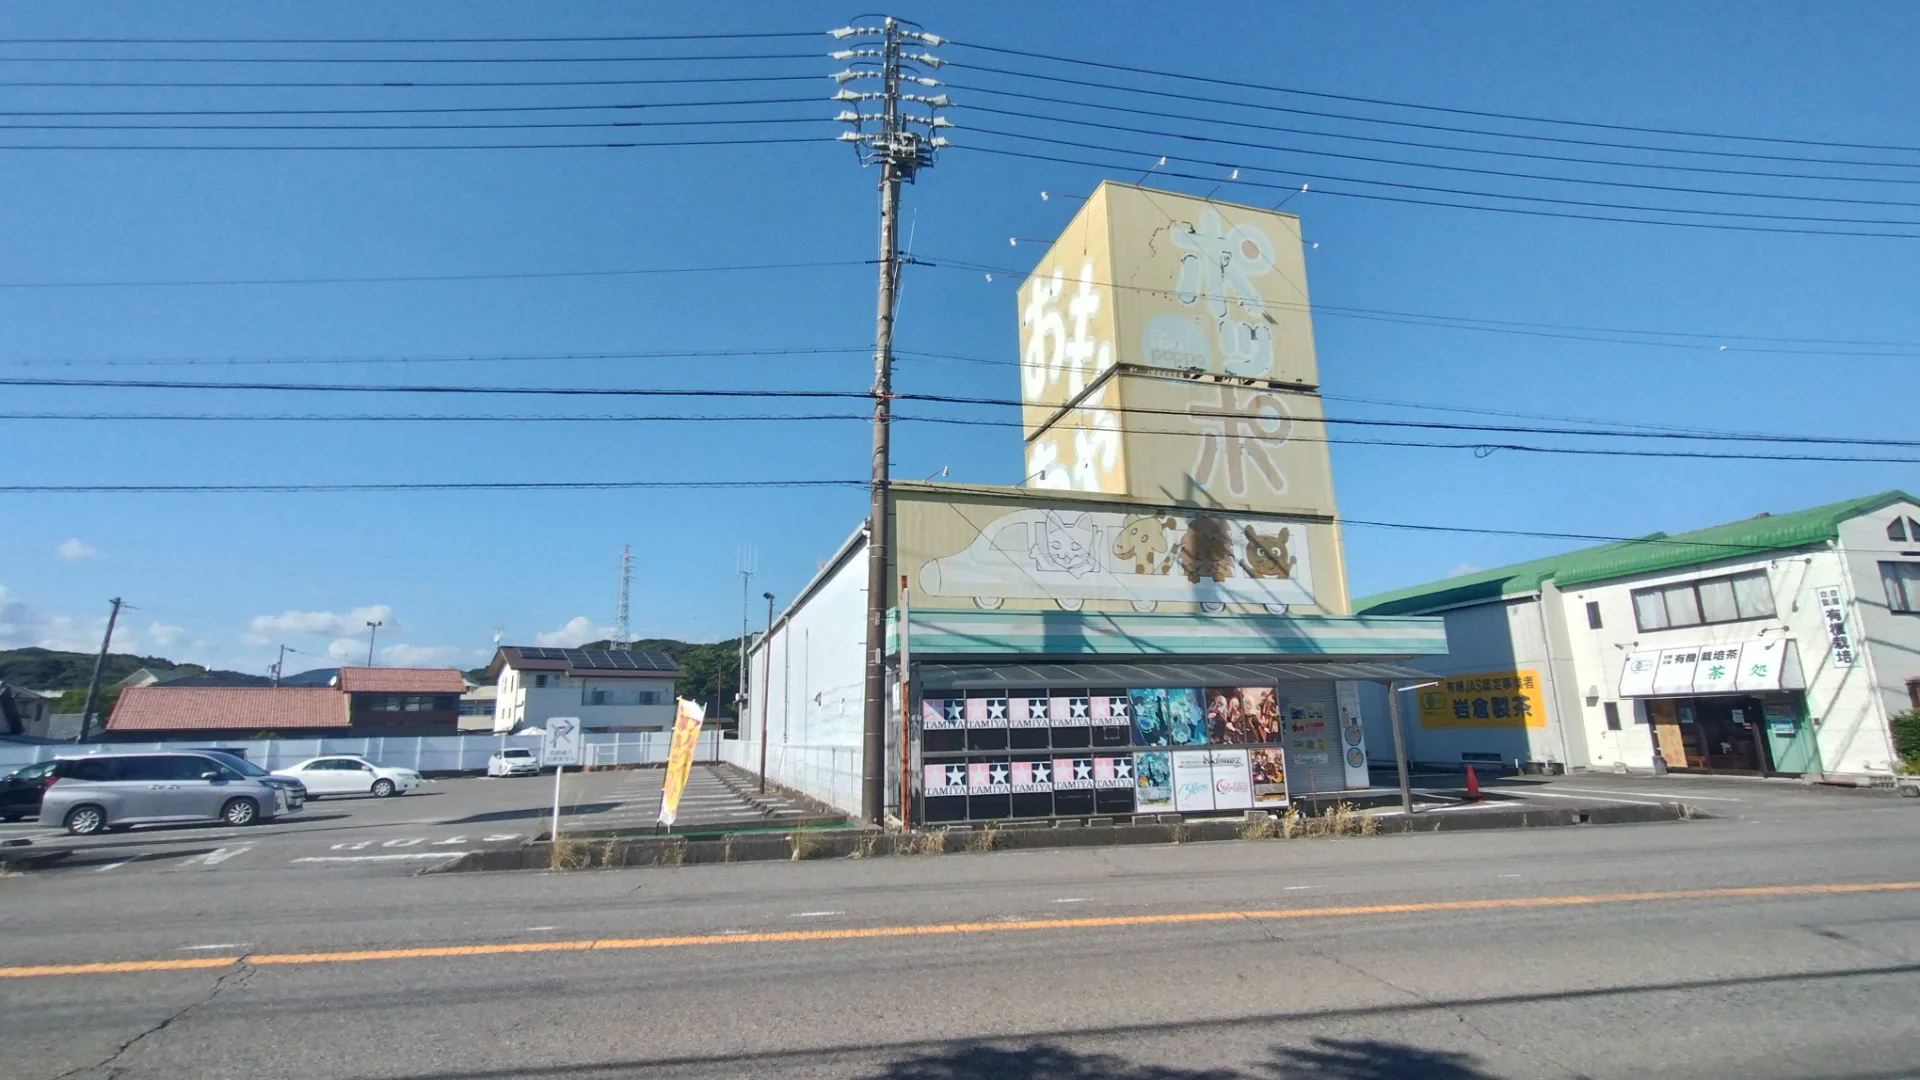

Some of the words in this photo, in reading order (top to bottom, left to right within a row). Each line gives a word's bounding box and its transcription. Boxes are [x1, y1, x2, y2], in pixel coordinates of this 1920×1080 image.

[1452, 695, 1533, 719] 岩倉製茶
[925, 720, 965, 729] TAMIYA
[967, 719, 1007, 728] TAMIYA
[1010, 719, 1049, 727] TAMIYA
[1051, 718, 1090, 726] TAMIYA
[1092, 717, 1129, 725] TAMIYA
[1012, 783, 1052, 792] TAMIYA
[1053, 780, 1094, 789] TAMIYA
[1095, 779, 1134, 788] TAMIYA
[925, 786, 967, 796] TAMIYA
[969, 784, 1010, 794] TAMIYA
